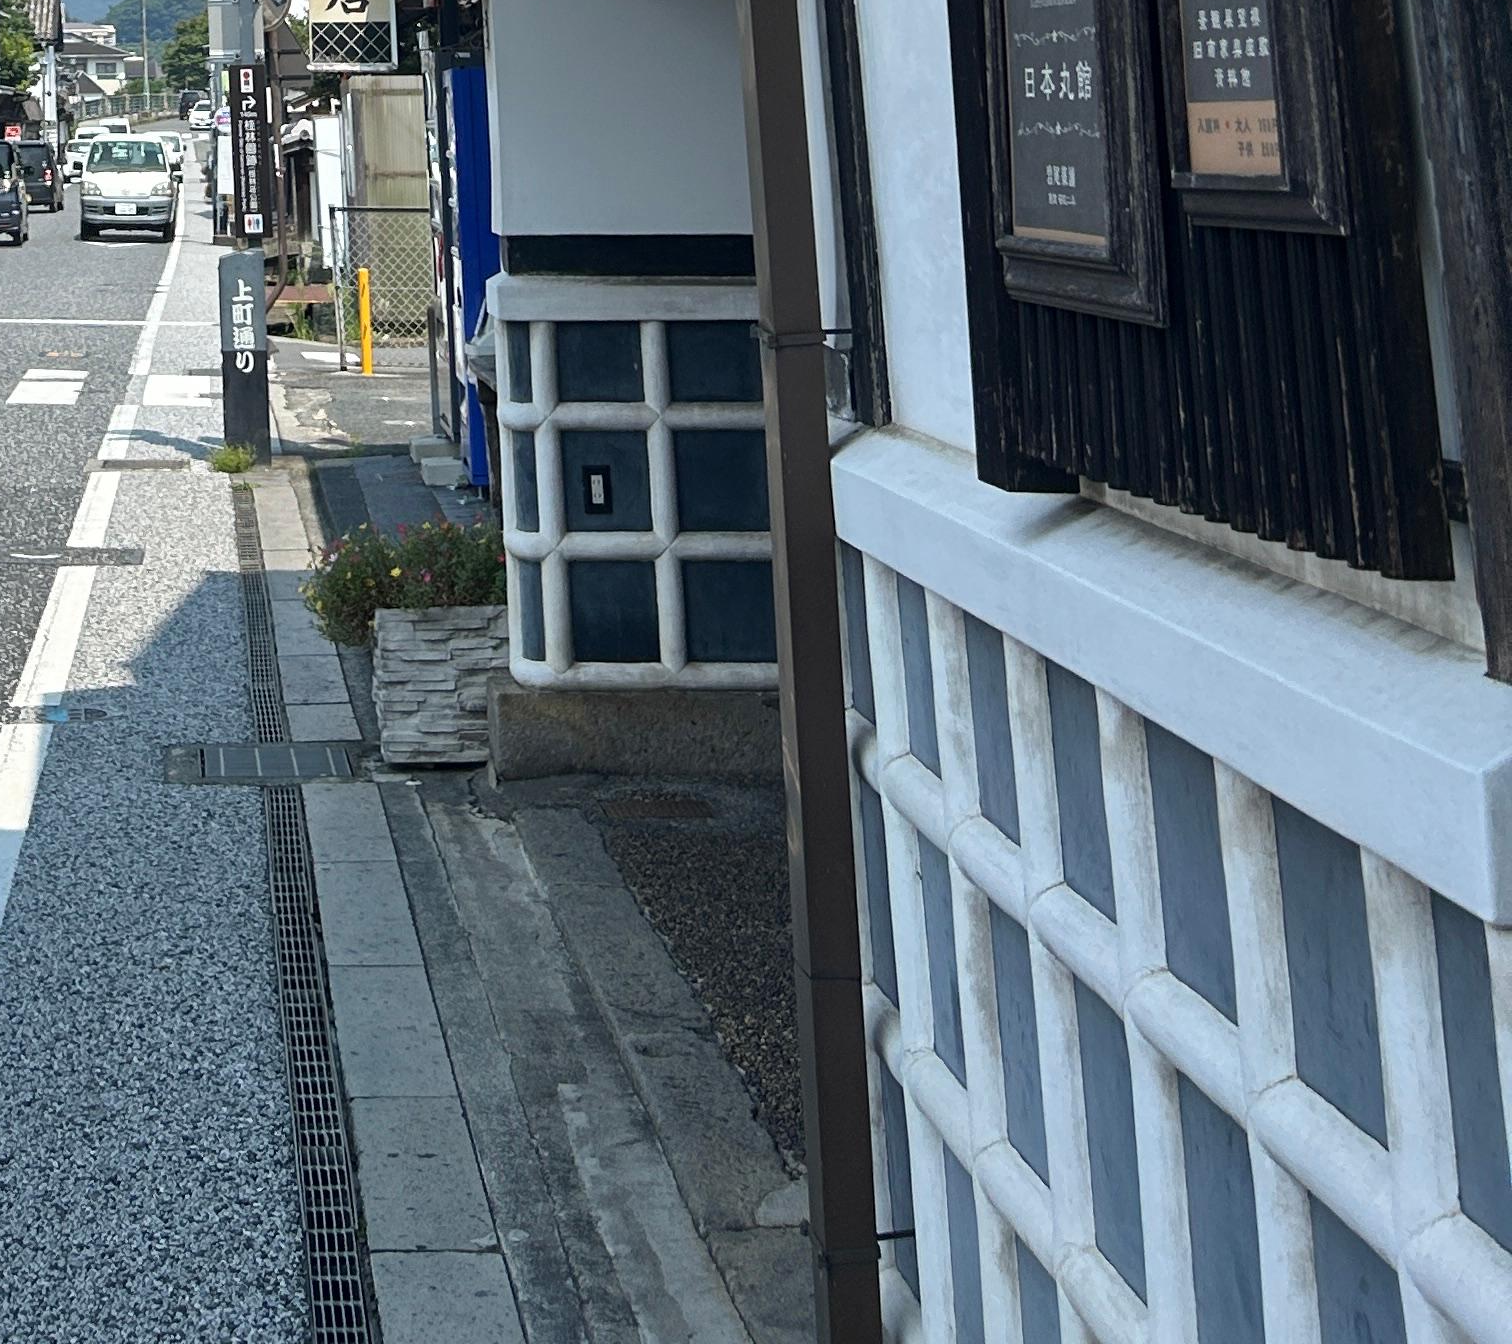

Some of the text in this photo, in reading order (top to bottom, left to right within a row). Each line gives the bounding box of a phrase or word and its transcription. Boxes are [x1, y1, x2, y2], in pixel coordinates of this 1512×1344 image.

[1024, 60, 1093, 101] 日本丸館
[232, 278, 256, 373] 上町通り
